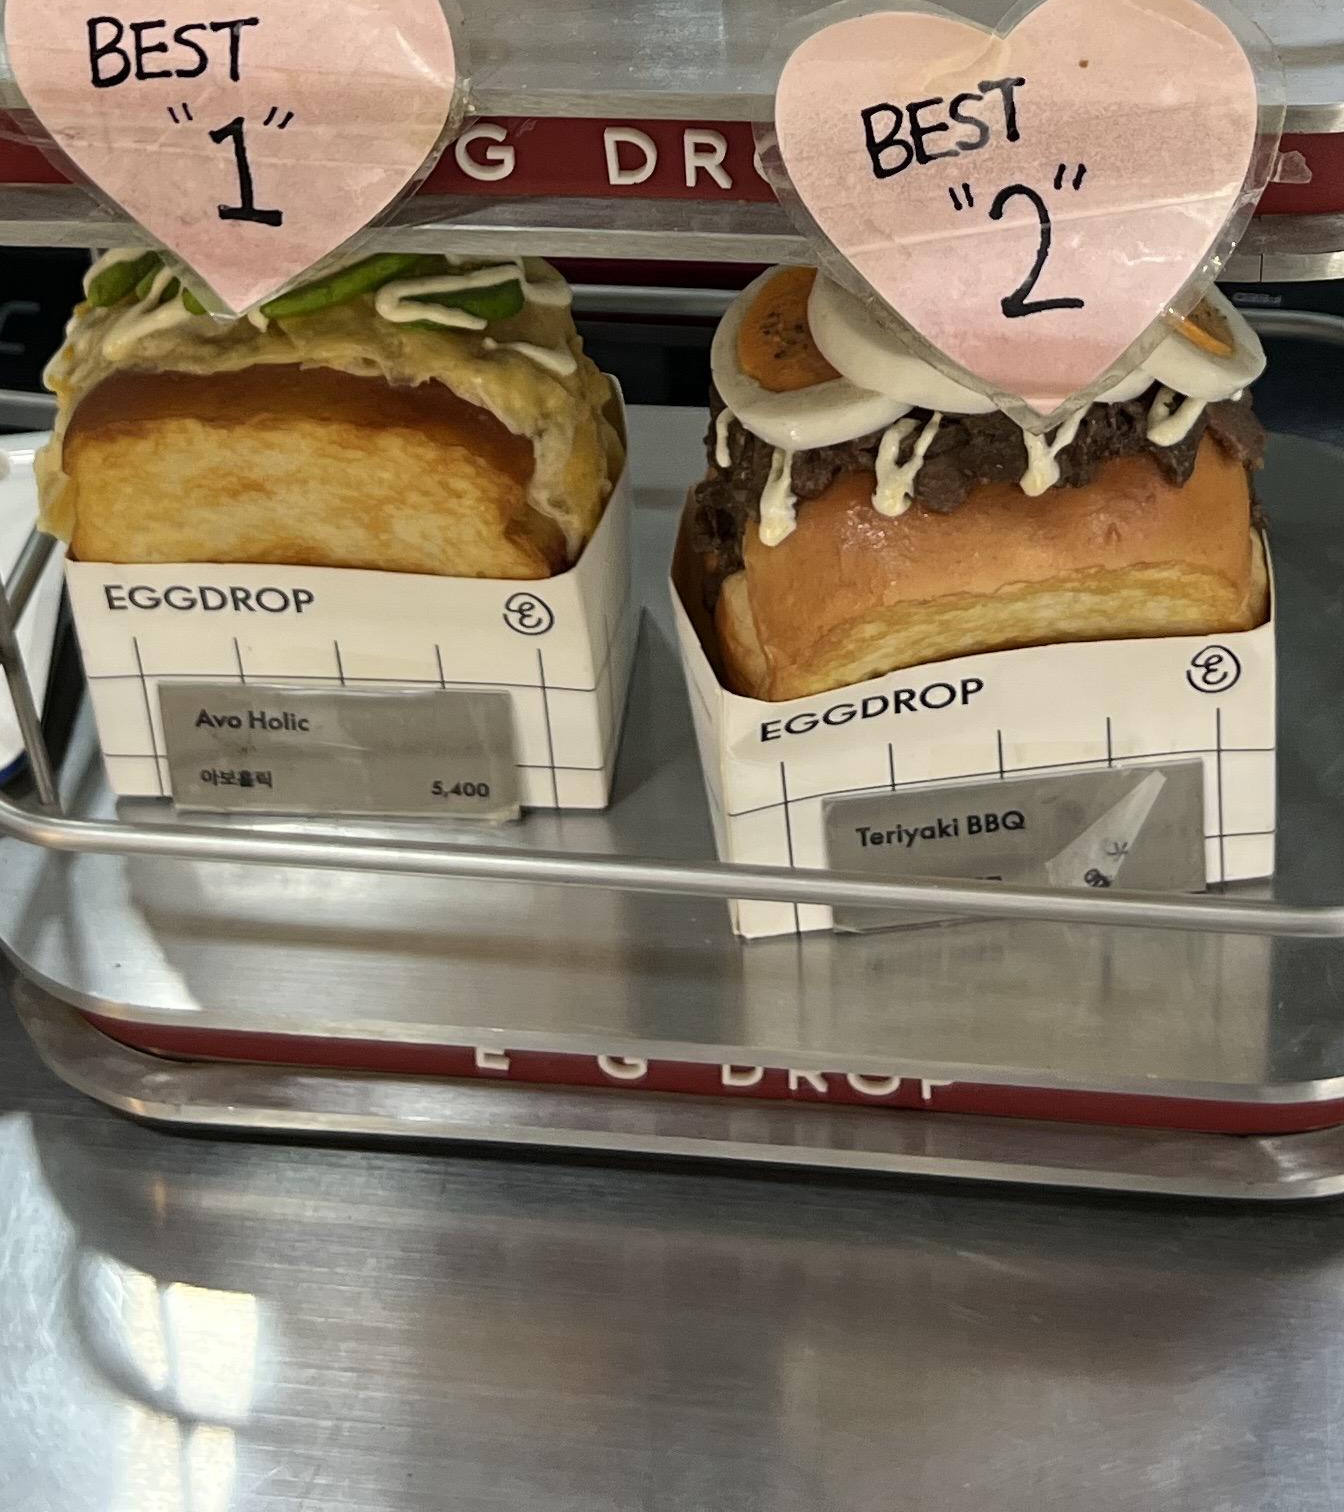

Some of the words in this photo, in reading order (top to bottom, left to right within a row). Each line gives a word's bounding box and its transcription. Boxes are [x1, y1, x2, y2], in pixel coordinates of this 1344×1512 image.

[86, 15, 260, 88] BEST
[860, 76, 1026, 180] BEST
[103, 584, 315, 614] EGGDROP
[194, 708, 242, 730] Avo
[247, 710, 311, 733] Holic
[760, 676, 985, 743] EGGDROP
[431, 780, 490, 798] 5,400
[856, 817, 960, 848] Teriyaki
[966, 809, 1026, 836] BBQ
